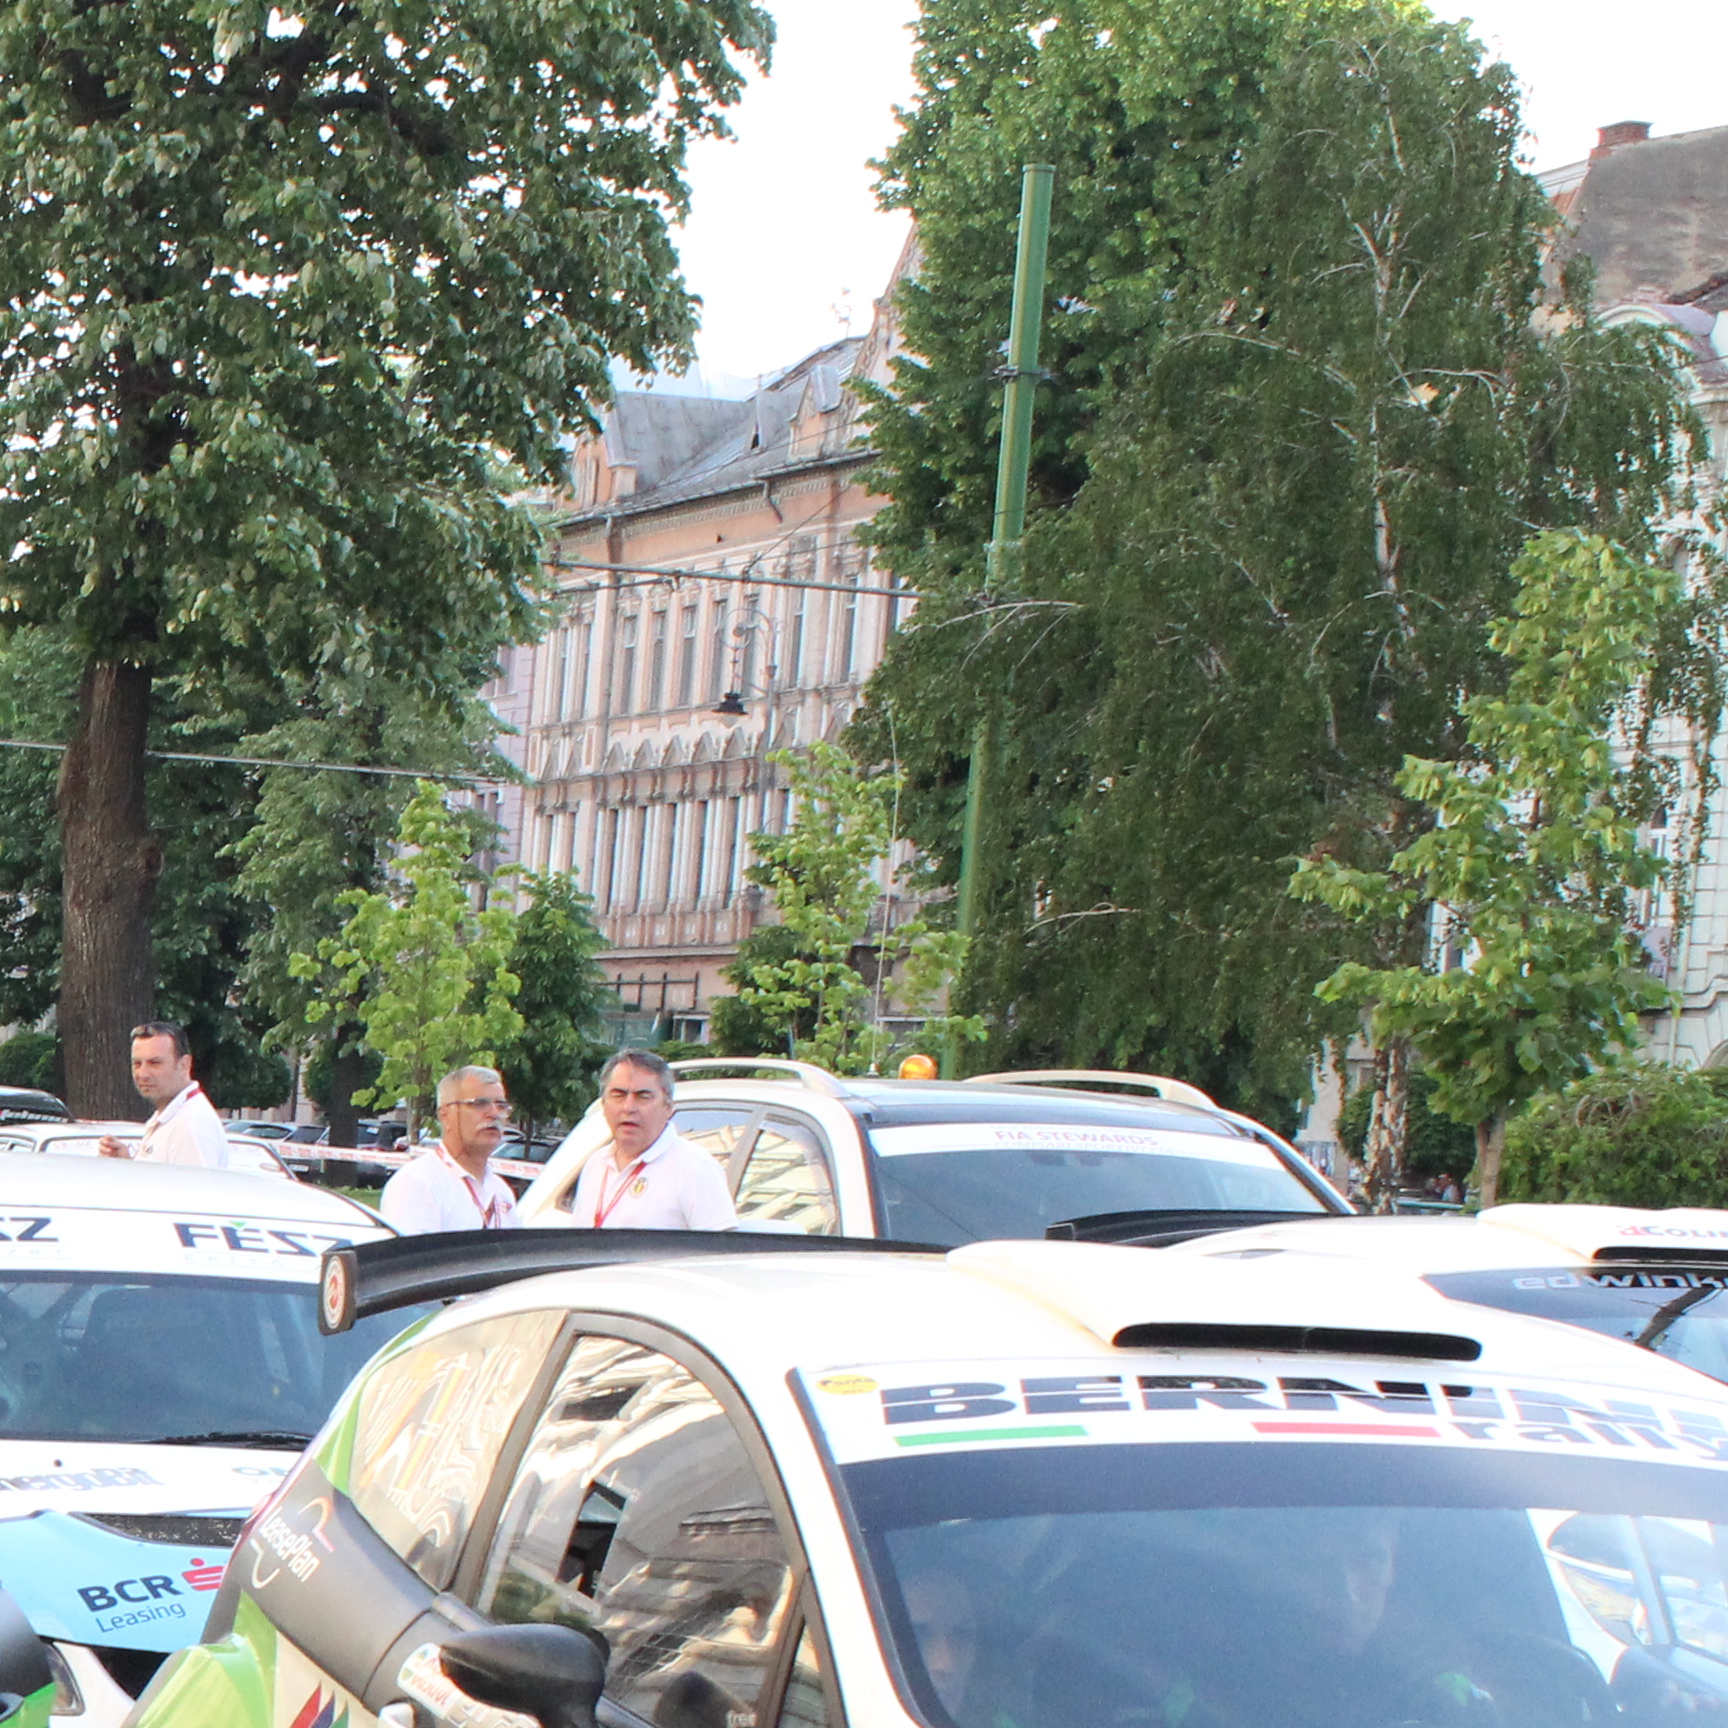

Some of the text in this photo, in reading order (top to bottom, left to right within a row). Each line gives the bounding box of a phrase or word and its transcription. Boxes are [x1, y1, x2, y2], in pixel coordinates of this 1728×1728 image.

[994, 1131, 1158, 1147] FIA STEWARDS
[258, 1507, 319, 1583] LeasePlan
[76, 1575, 185, 1612] BCR
[95, 1602, 187, 1634] Leasing
